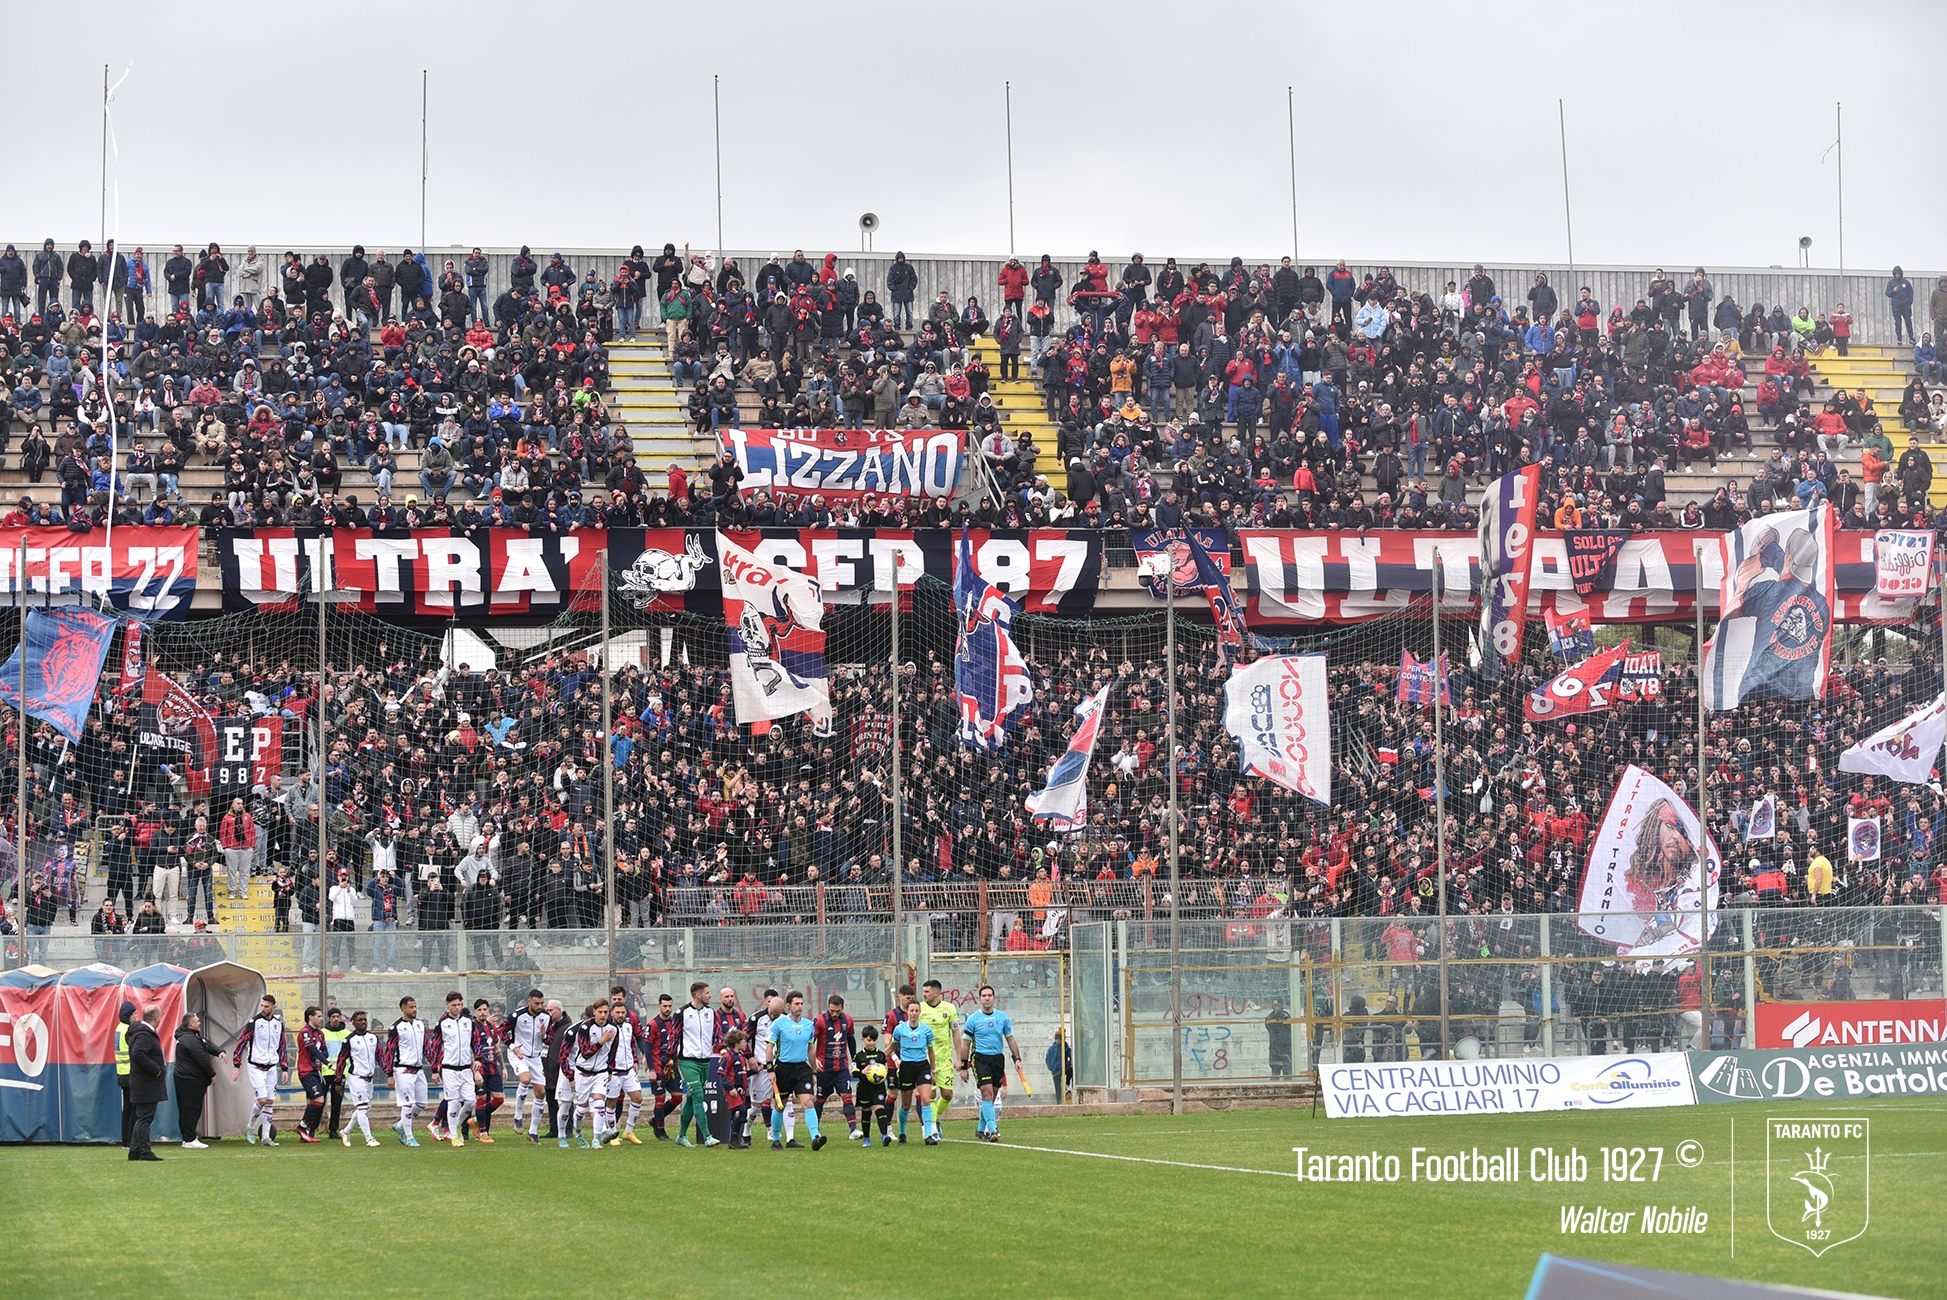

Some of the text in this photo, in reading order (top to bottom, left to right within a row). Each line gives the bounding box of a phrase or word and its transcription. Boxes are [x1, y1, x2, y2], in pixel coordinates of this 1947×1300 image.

[729, 429, 958, 498] LIZZANO
[1573, 535, 1605, 550] SOLO
[129, 546, 185, 609] 22
[233, 536, 579, 606] ULTRA'
[1331, 1063, 1561, 1092] CENTRALLUMINIO
[1762, 1057, 1835, 1098] De
[1808, 1051, 1893, 1069] AGENZIA
[1334, 1088, 1540, 1115] VIA CAGLIARI 17
